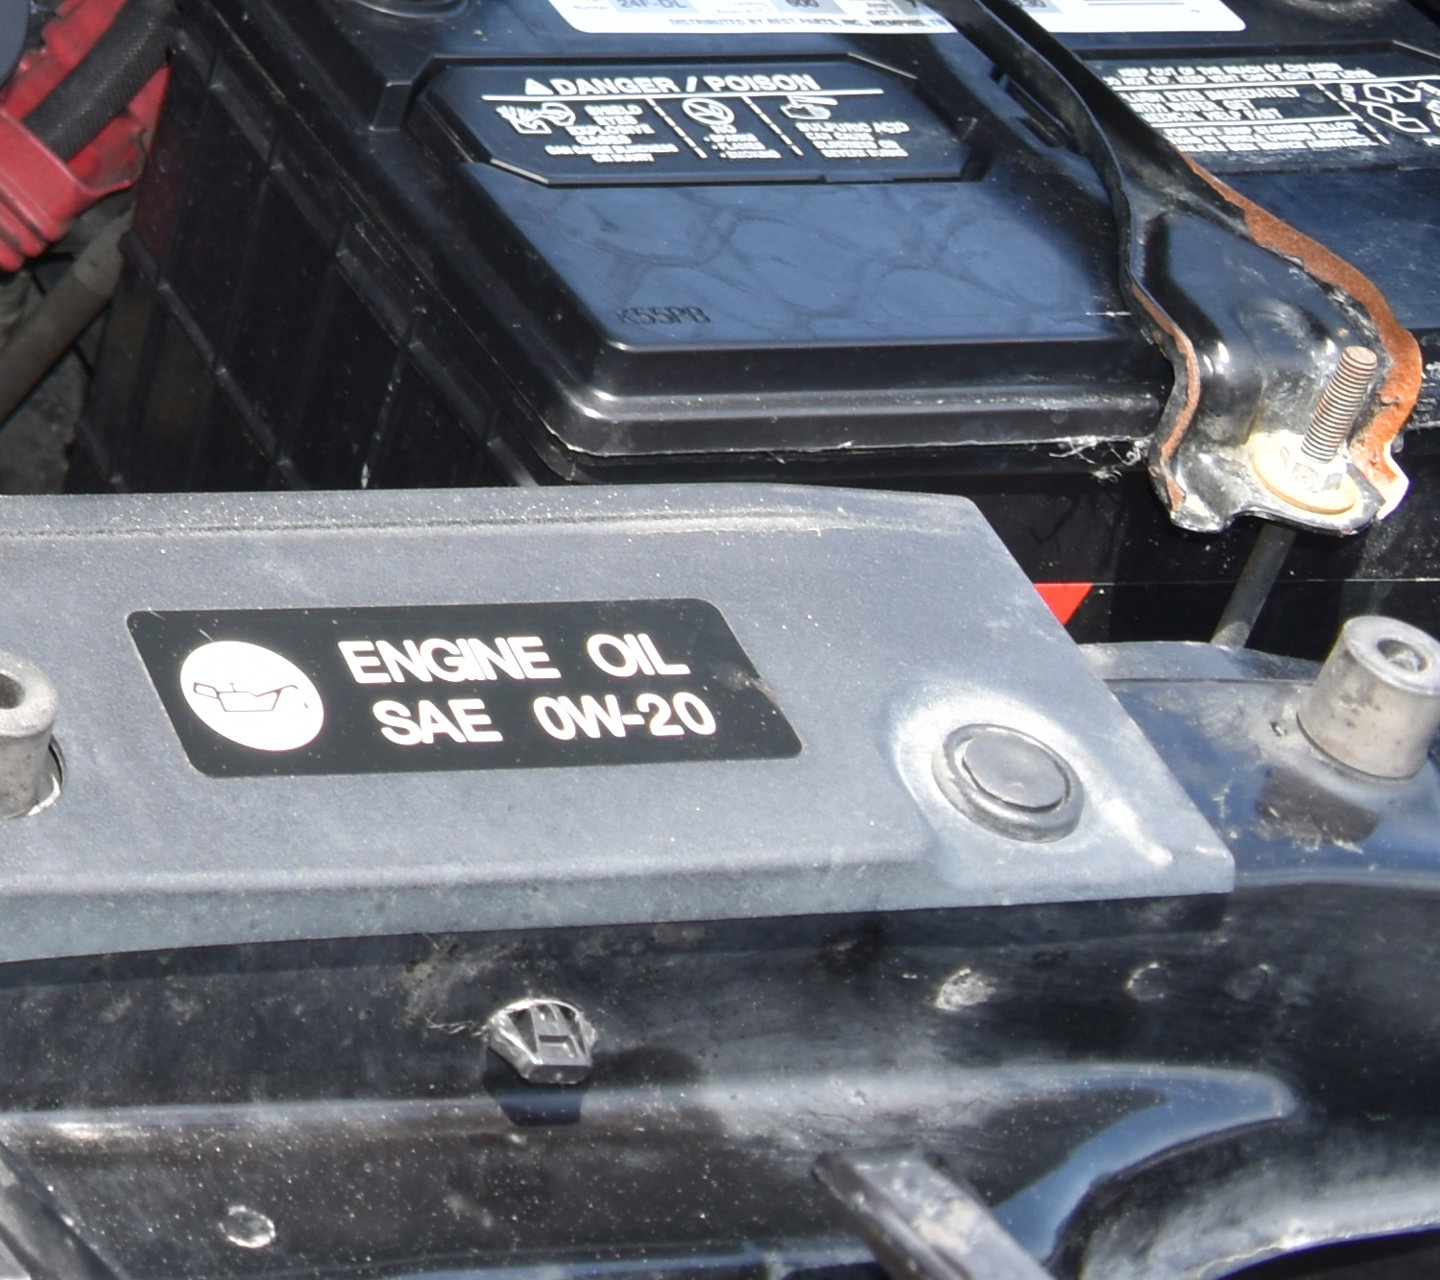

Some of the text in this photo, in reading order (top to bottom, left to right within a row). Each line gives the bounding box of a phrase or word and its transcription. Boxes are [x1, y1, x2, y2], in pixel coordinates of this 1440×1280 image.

[548, 76, 681, 95] DANGER
[702, 73, 822, 92] POISON
[1163, 91, 1207, 101] EYES
[1203, 88, 1301, 100] IMMEDIATELY
[584, 104, 644, 116] SHIELD
[592, 115, 639, 126] EYES
[565, 124, 656, 136] EXPLOSIVE
[710, 124, 738, 134] NO
[795, 122, 910, 133] SULFURIC ACID
[337, 633, 691, 685] ENGINE OIL
[371, 691, 717, 746] SAE 0W-20
